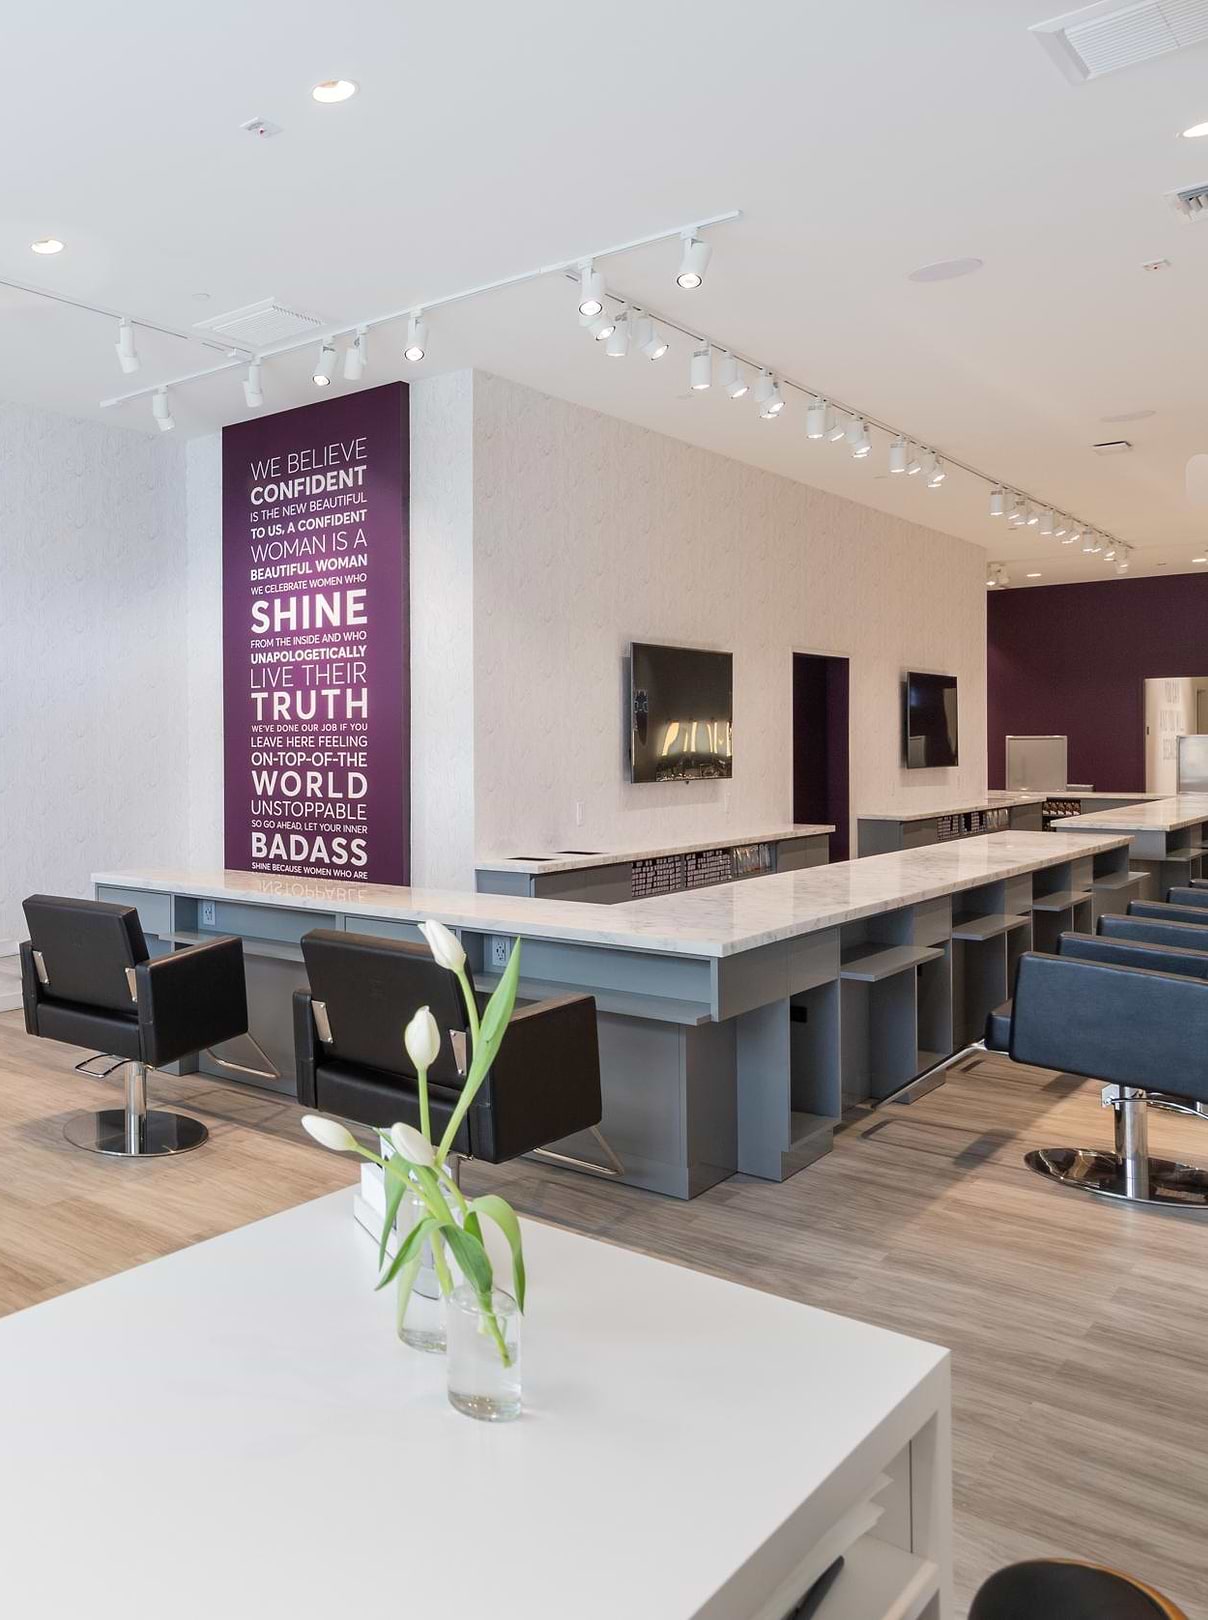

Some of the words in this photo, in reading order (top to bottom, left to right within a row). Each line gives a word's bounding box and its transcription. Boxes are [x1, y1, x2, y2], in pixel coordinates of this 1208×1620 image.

[250, 457, 281, 480] WE
[288, 437, 367, 474] BELIEVE
[250, 465, 367, 505] CONFIDENT
[250, 511, 259, 522] IS
[261, 509, 279, 521] THE
[282, 503, 307, 517] NEW
[310, 492, 367, 513] BEAUTIFUL
[251, 527, 265, 539] TO
[268, 525, 285, 537] US,
[287, 522, 296, 533] A
[298, 509, 367, 531] CONFIDENT
[250, 535, 325, 563] WOMAN
[332, 531, 347, 551] IS
[353, 529, 367, 549] A
[250, 561, 312, 581] BEAUTIFUL
[315, 554, 367, 573] WOMAN
[250, 586, 263, 595] WE
[265, 580, 307, 594] CELEBRATE
[309, 576, 343, 589] WOMEN
[344, 573, 367, 584] WHO
[251, 589, 367, 634] SHINE
[251, 638, 274, 648] FROM
[276, 637, 291, 647] THE
[293, 634, 319, 645] INSIDE
[321, 632, 341, 643] AND
[343, 630, 367, 641] WHO
[251, 645, 367, 664] UNAPOLOGETICALLY
[251, 666, 293, 689] LIVE
[301, 662, 367, 686] THEIR
[251, 688, 368, 721] TRUTH
[277, 724, 299, 732] DONE
[301, 724, 319, 732] OUR
[321, 724, 337, 732] JOB
[350, 723, 368, 731] YOU
[251, 737, 283, 747] LEAVE
[287, 736, 315, 747] HERE
[319, 736, 368, 747] FEELING
[251, 752, 368, 767] ON-TOP-OF-THE
[252, 770, 368, 799] WORLD
[251, 800, 367, 820] UNSTOPPABLE
[251, 820, 262, 828] SO
[263, 821, 275, 829] GO
[277, 821, 303, 831] AHEAD,
[304, 823, 318, 831] LET
[320, 823, 341, 833] YOUR
[343, 825, 368, 834] INNER
[252, 832, 368, 866] BADASS
[252, 862, 271, 871] SHINE
[272, 863, 302, 874] BECAUSE
[303, 866, 331, 876] WOMEN
[333, 869, 352, 879] WHO
[353, 871, 368, 879] ARE
